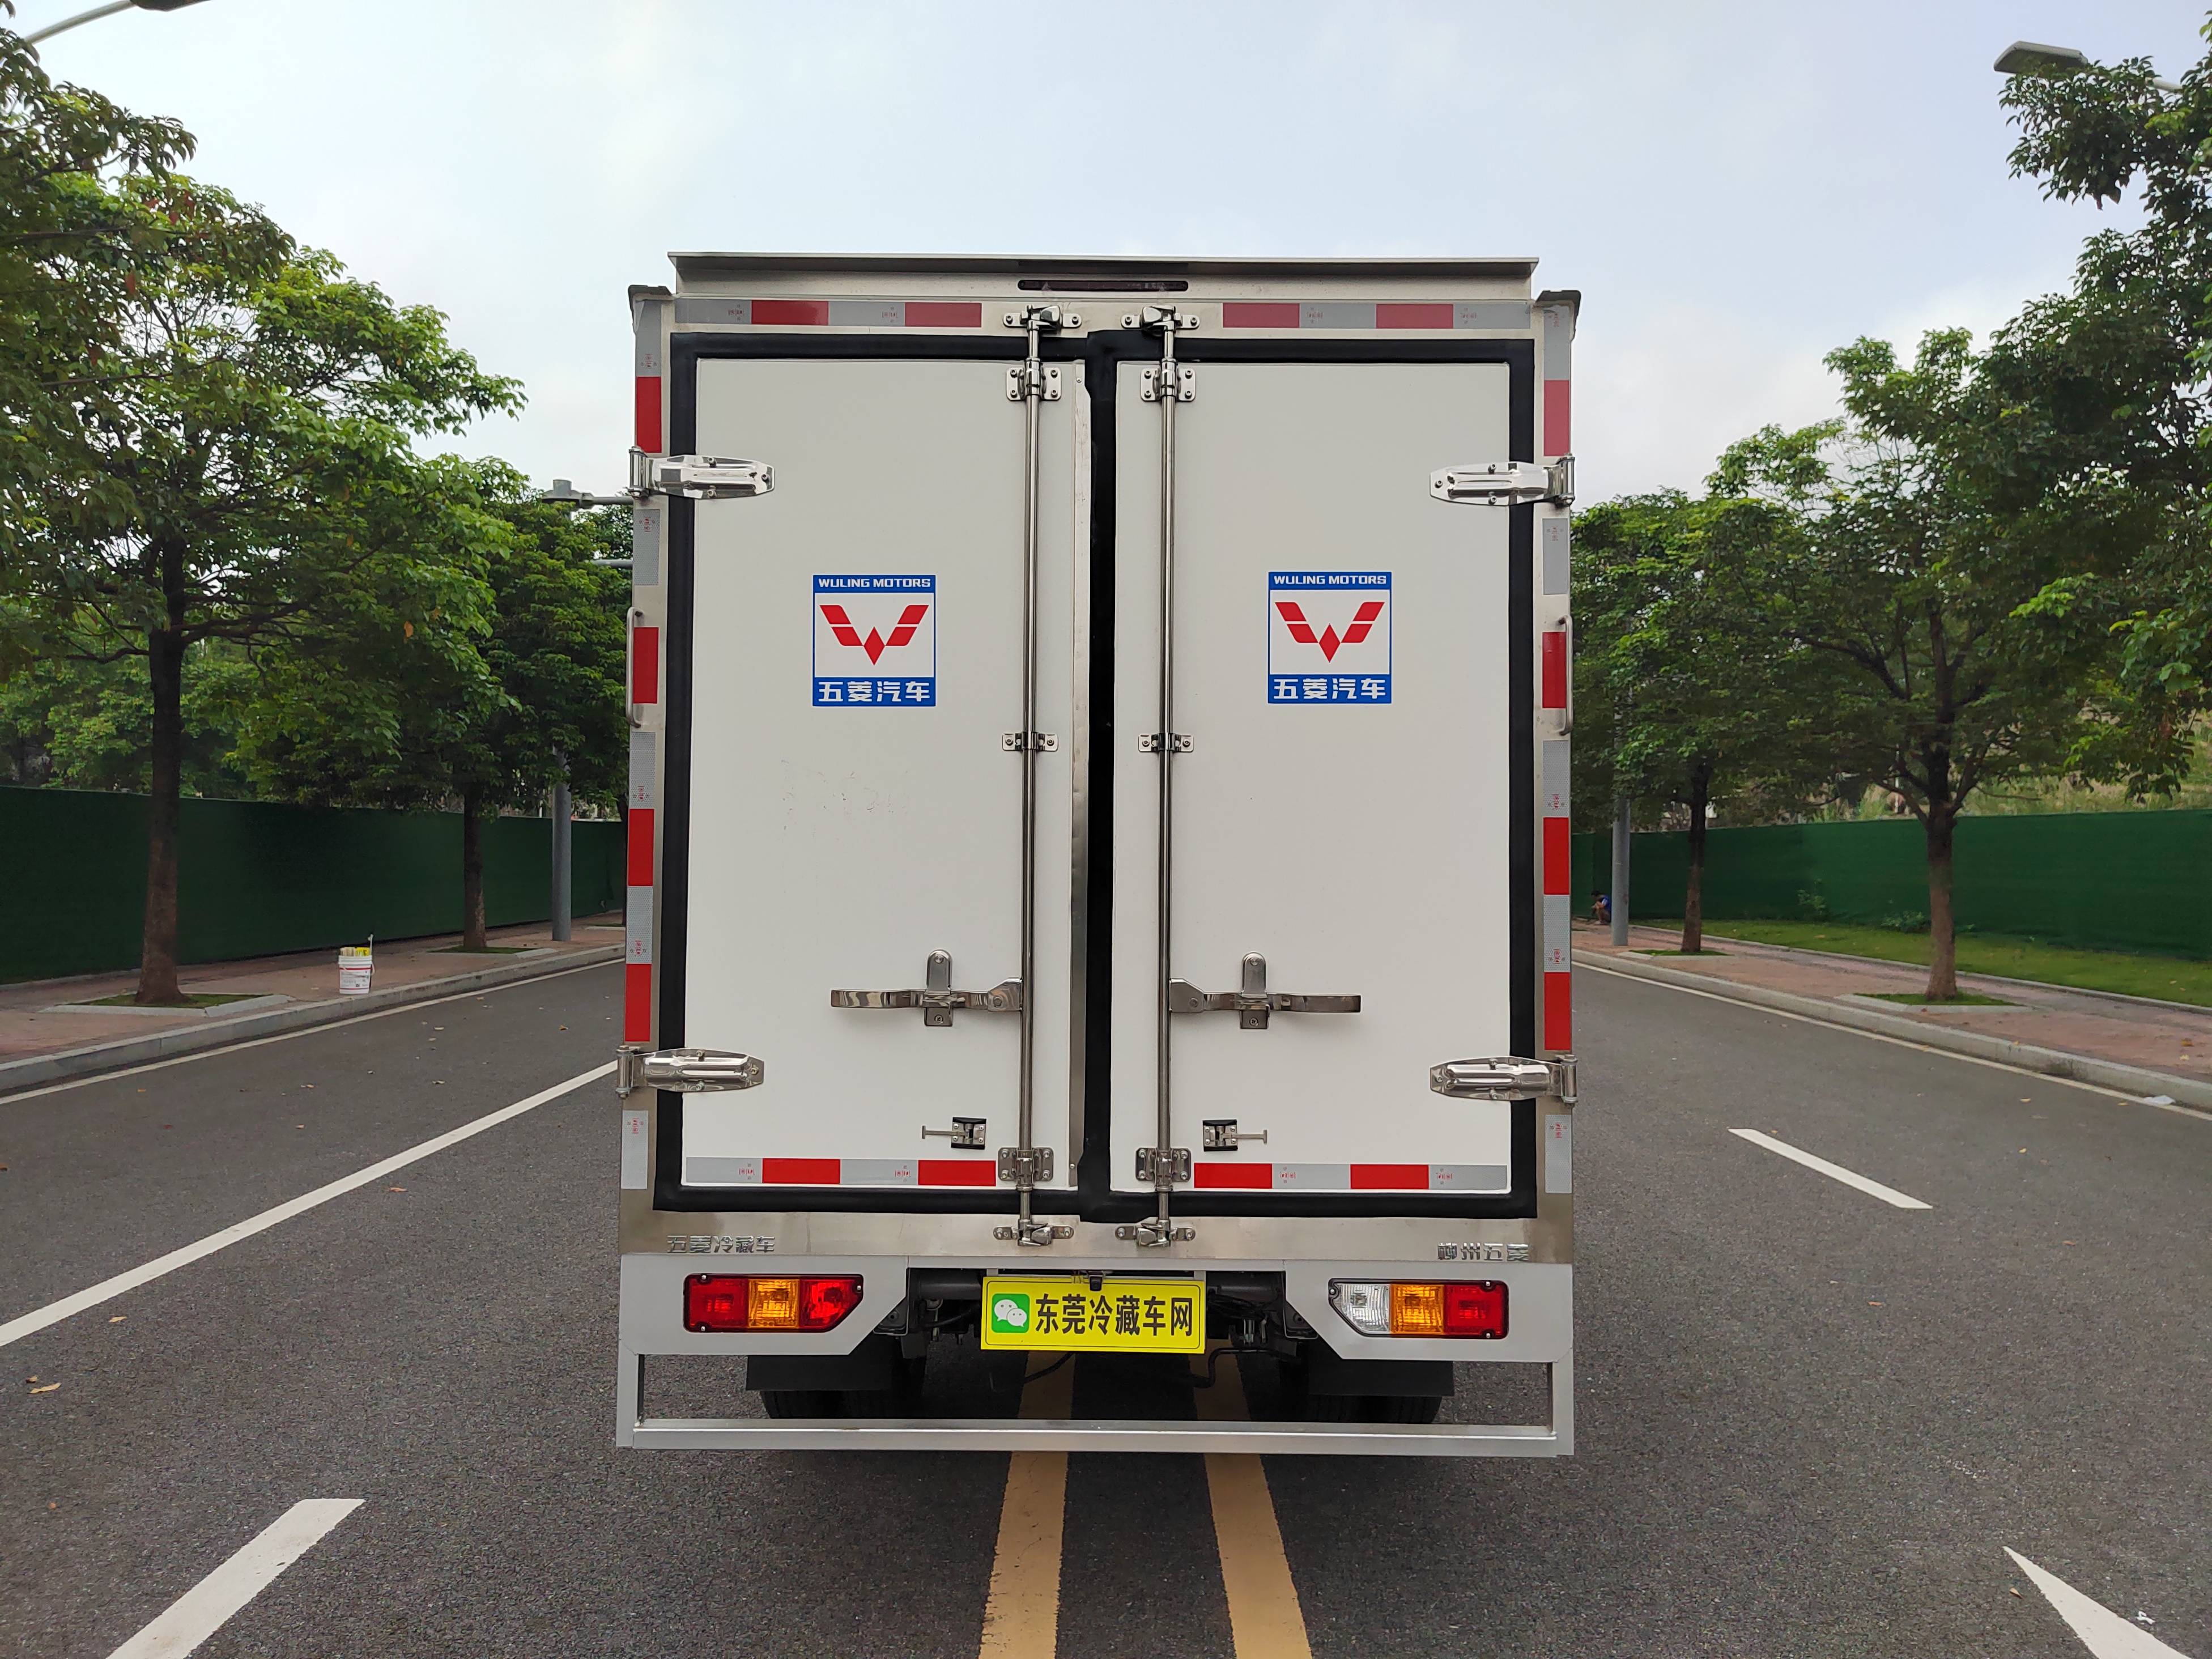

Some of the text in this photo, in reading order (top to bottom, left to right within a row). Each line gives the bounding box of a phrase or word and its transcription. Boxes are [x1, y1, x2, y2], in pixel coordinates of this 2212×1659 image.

[818, 578, 931, 588] WULING MOTORS
[1274, 575, 1386, 585] WULING MOTORS
[818, 681, 930, 702] 五菱汽车
[1273, 678, 1386, 699] 五菱汽车
[667, 1235, 775, 1253] 五菱冷藏车
[1437, 1242, 1529, 1262] 柳州五菱
[1035, 1293, 1193, 1336] 东莞冷藏车网
